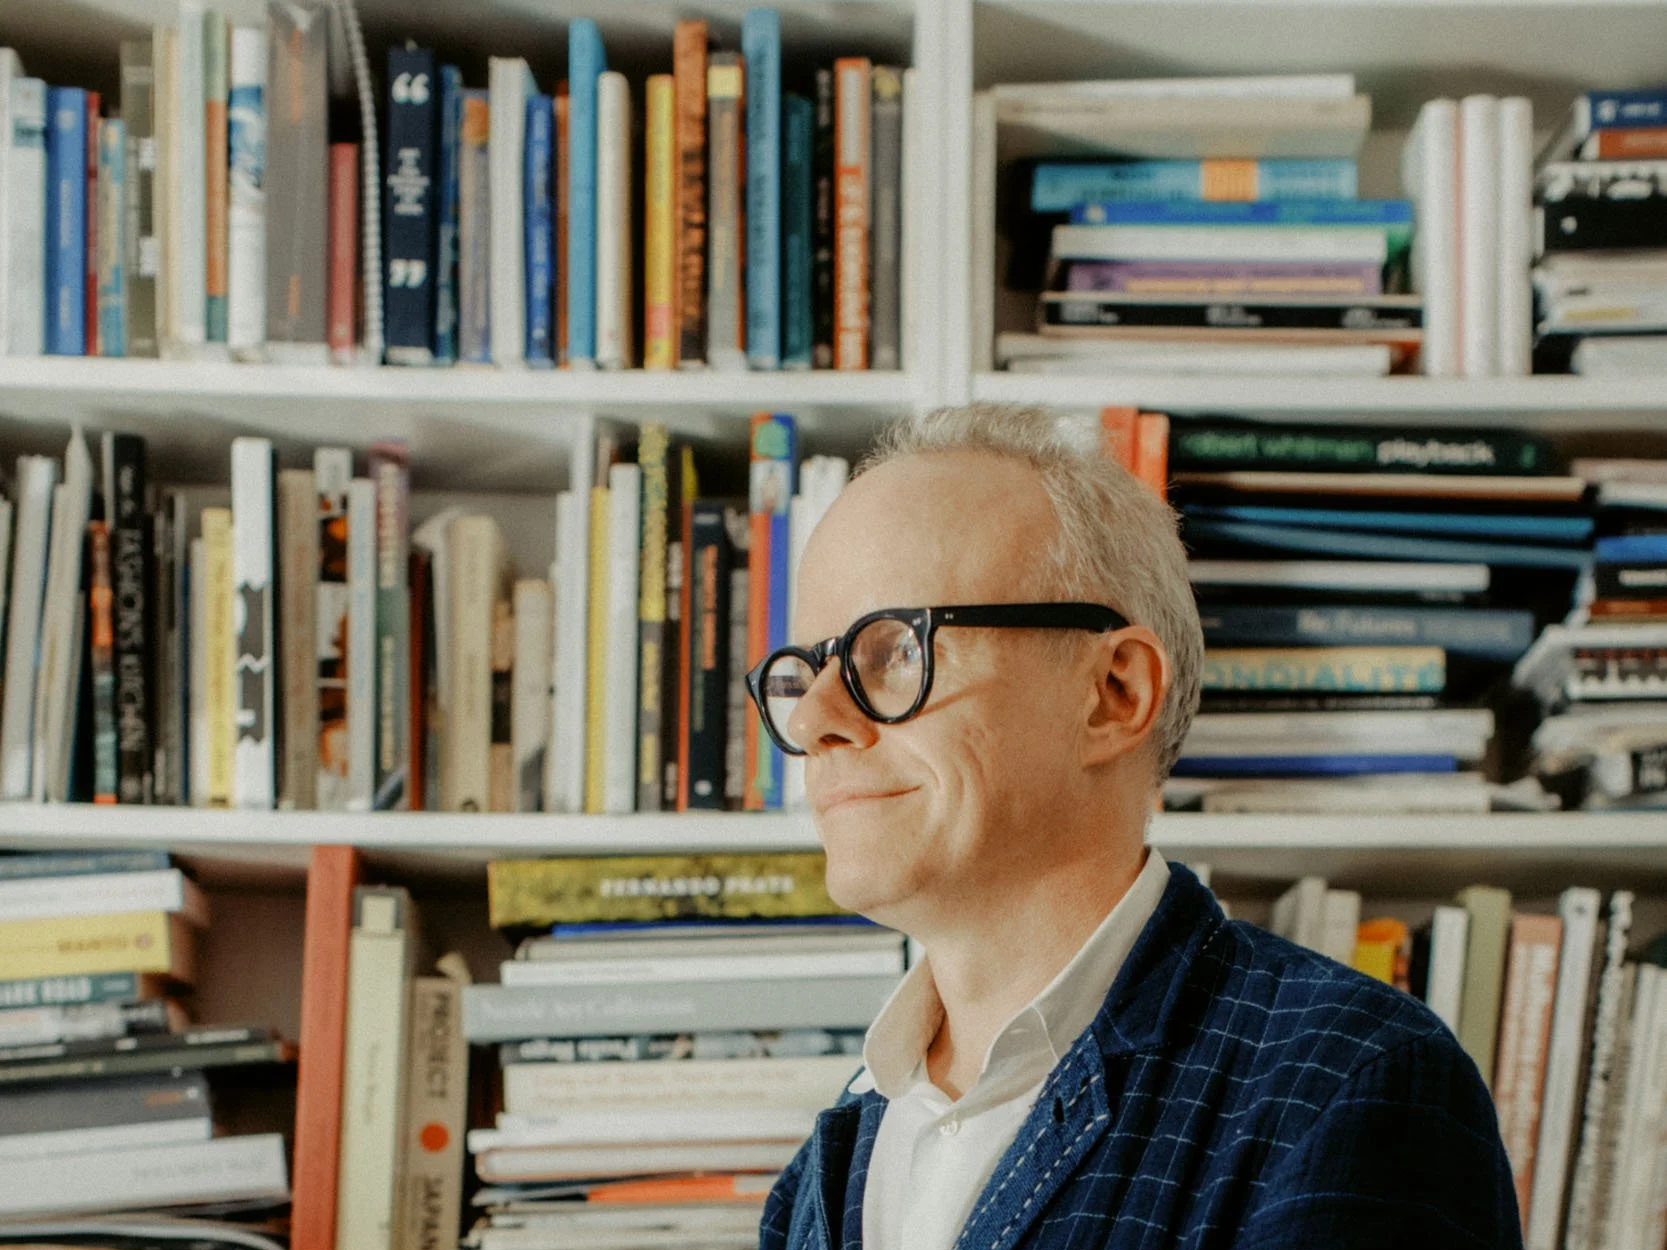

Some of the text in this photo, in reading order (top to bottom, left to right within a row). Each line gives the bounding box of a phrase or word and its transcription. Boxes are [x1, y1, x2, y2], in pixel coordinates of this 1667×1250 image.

[1377, 438, 1495, 467] playback
[600, 876, 721, 898] FERNANDO
[426, 991, 451, 1100] PROJECT
